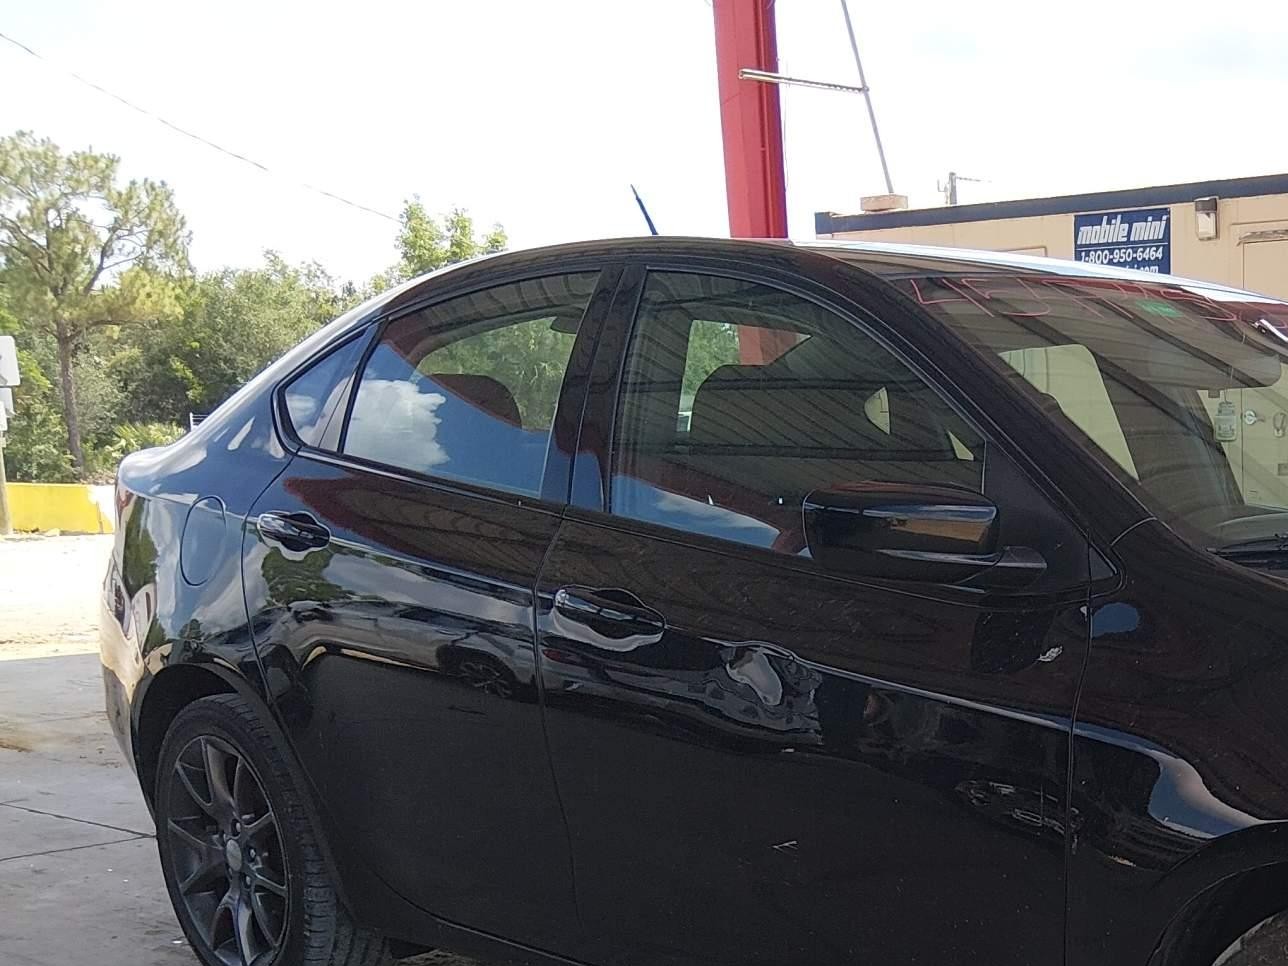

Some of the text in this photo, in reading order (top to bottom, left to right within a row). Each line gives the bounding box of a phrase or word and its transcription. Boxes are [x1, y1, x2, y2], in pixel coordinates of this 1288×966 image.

[1077, 215, 1167, 245] mobile mini
[1080, 246, 1163, 264] 1-800-950-6464
